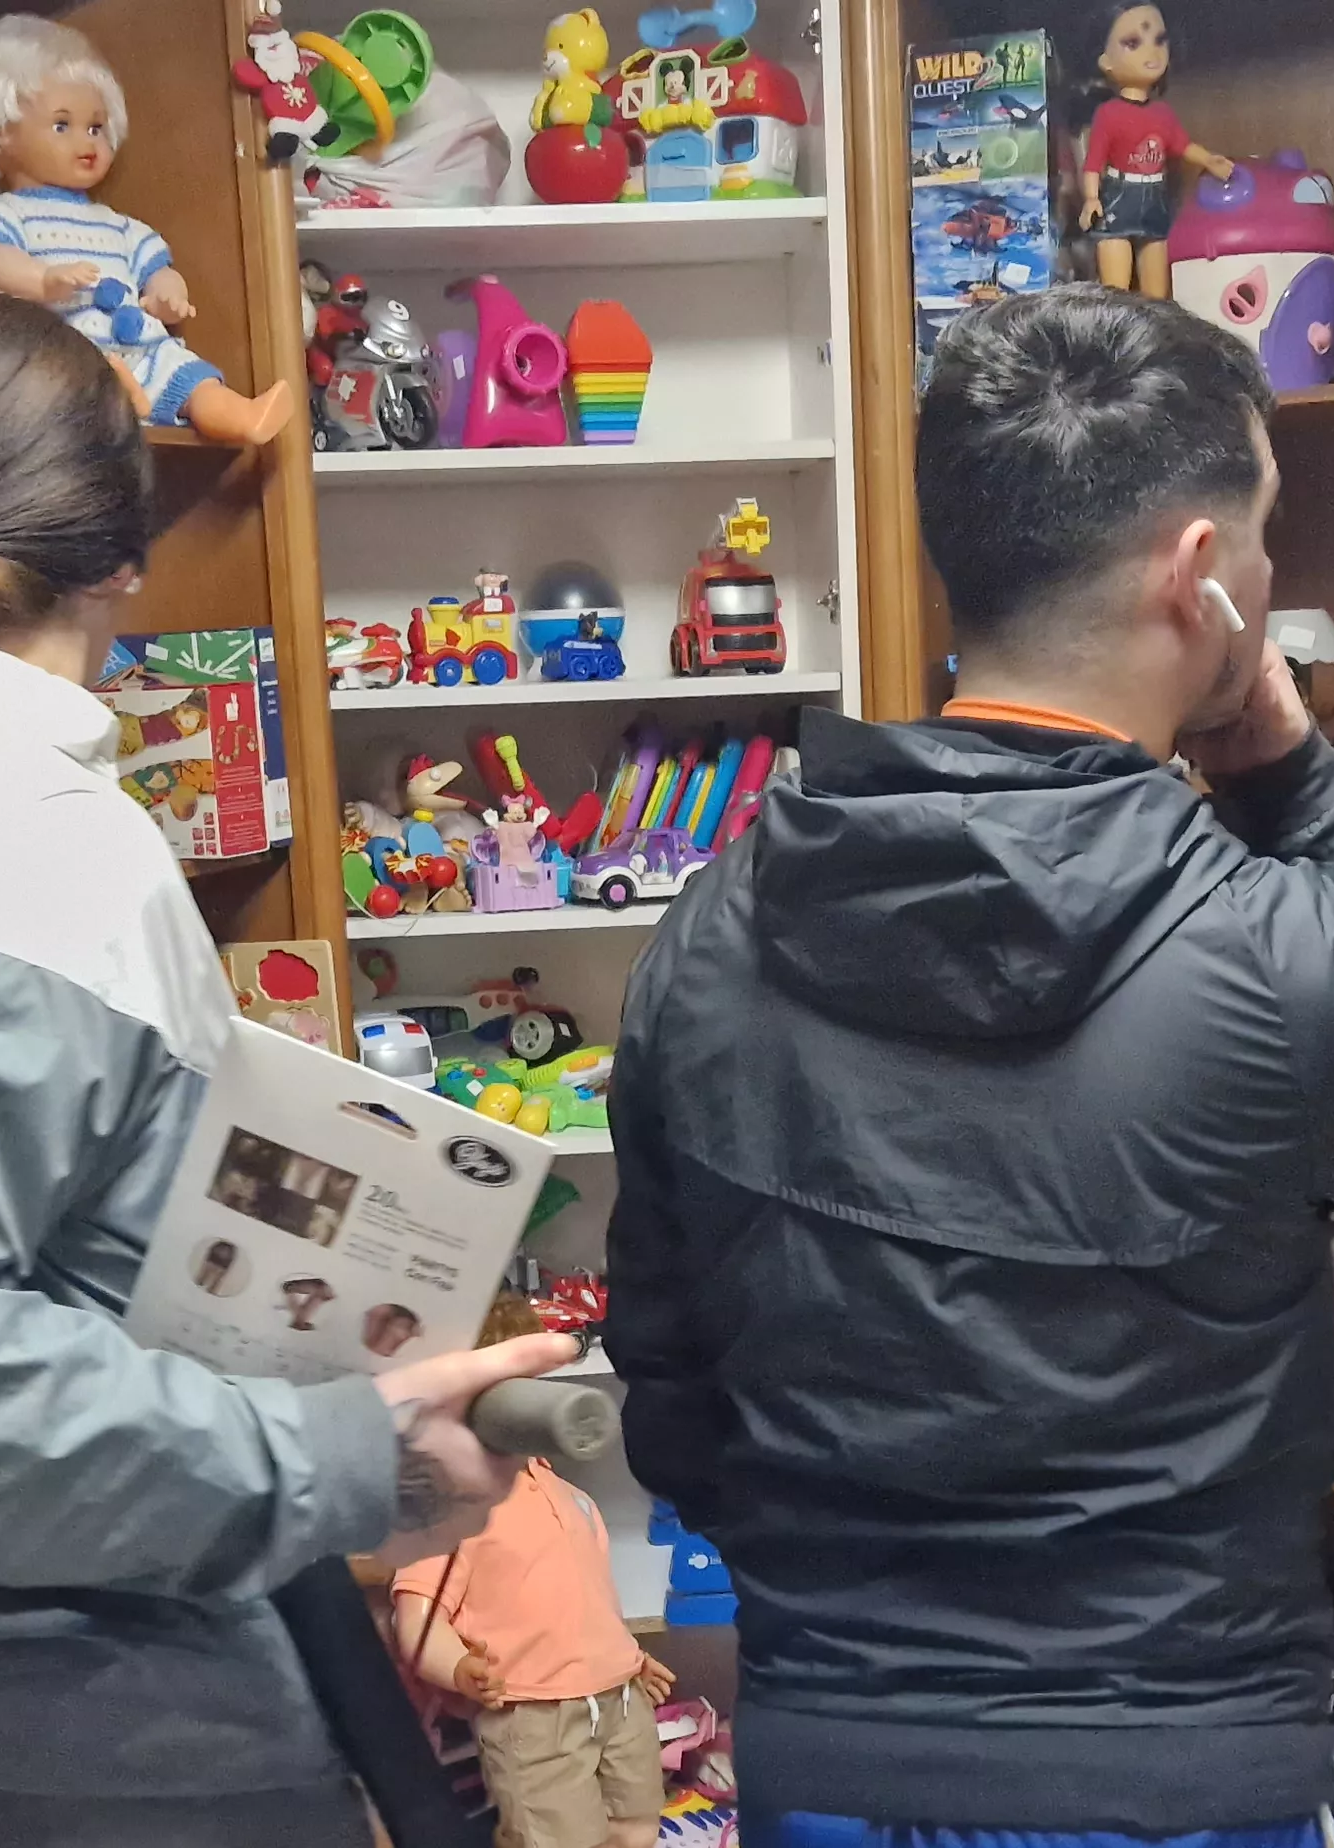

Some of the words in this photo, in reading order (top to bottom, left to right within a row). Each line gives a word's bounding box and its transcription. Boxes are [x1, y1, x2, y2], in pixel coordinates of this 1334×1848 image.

[916, 50, 984, 82] WILD
[913, 79, 975, 100] QUEST
[387, 299, 410, 321] 9
